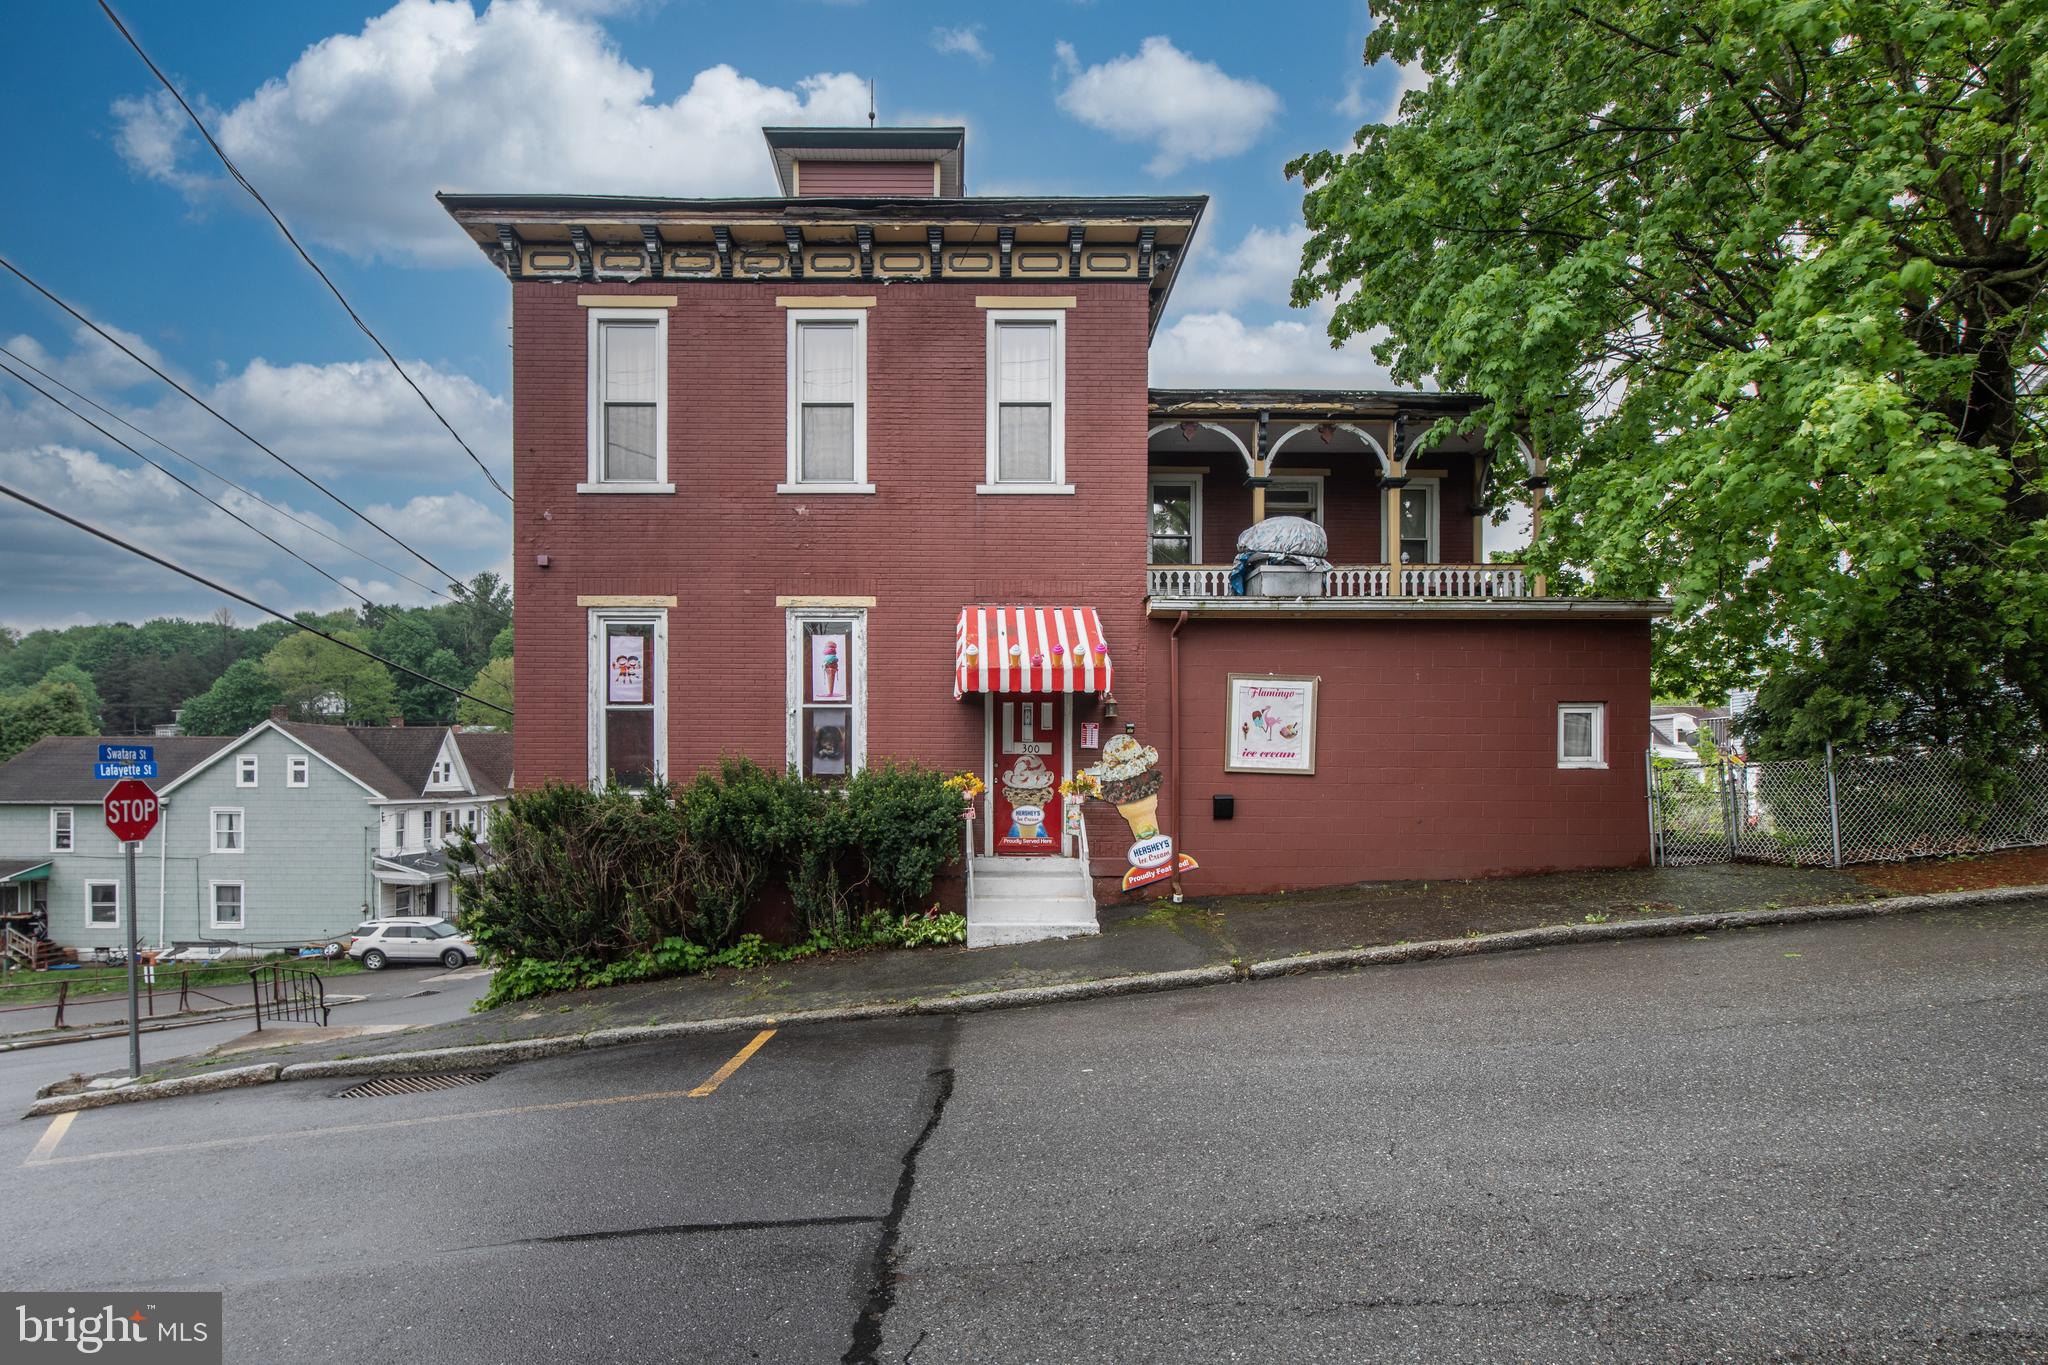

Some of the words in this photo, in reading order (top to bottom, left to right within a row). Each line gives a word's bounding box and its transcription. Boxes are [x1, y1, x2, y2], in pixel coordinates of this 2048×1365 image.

[1250, 686, 1295, 699] Flamingo
[106, 747, 137, 760] Swatara
[139, 749, 147, 760] St
[1021, 743, 1040, 754] 300
[1242, 748, 1257, 757] ice
[100, 763, 141, 777] Lafayette
[143, 764, 152, 775] St
[108, 798, 155, 824] STOP
[1133, 839, 1170, 858] HERSHEY'S
[1137, 857, 1147, 865] Ice
[1148, 851, 1171, 861] Cream
[1128, 870, 1156, 884] Proudly
[1156, 859, 1190, 875] Feated!
